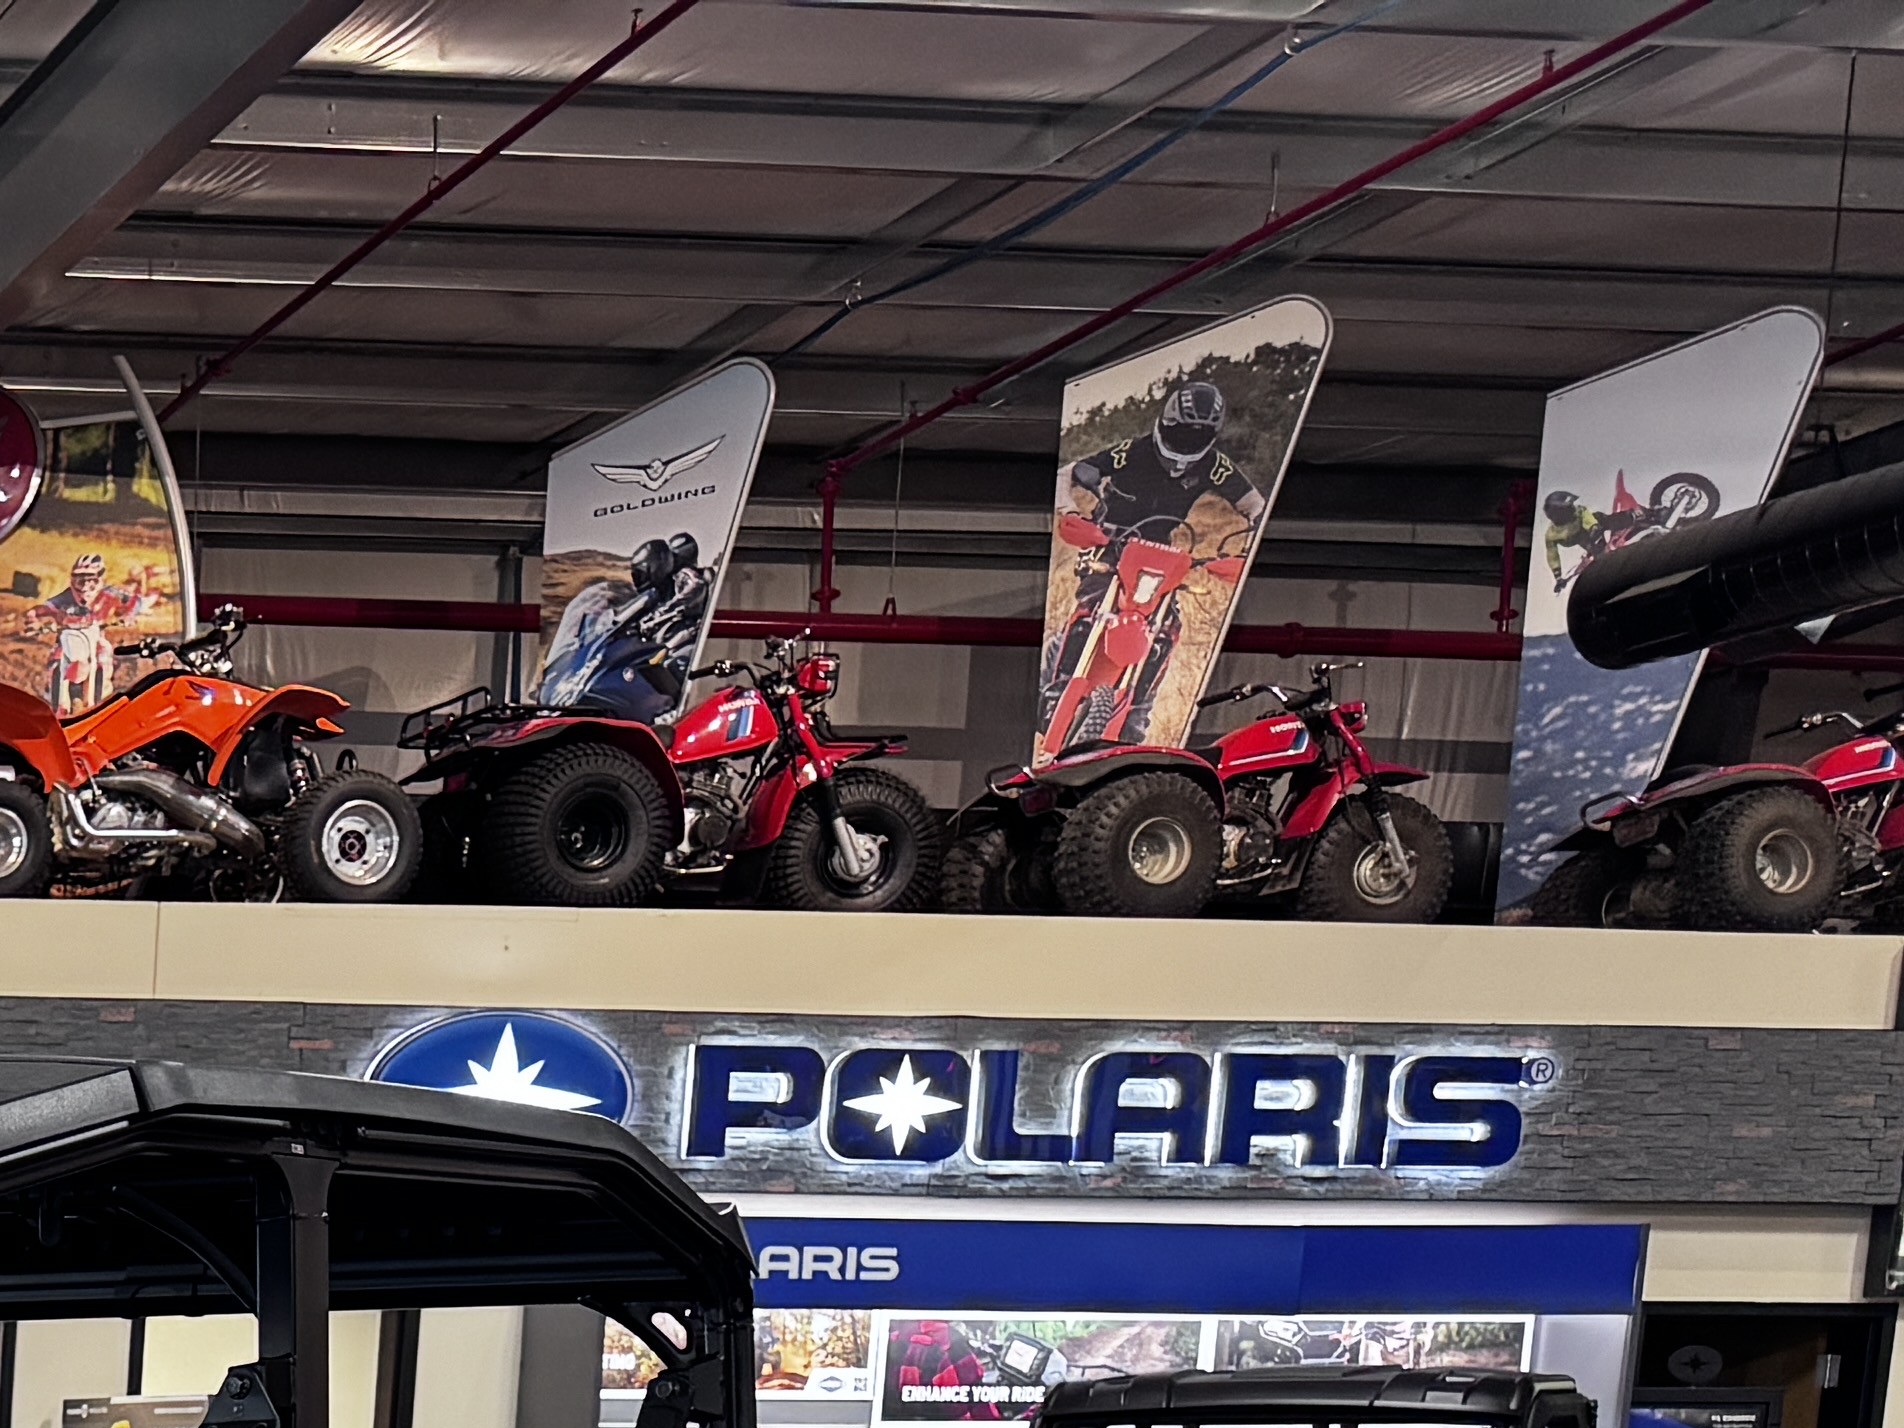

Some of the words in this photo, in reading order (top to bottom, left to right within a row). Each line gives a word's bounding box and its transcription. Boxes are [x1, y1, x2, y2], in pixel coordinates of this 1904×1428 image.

[593, 484, 716, 519] GOLDWING
[685, 1043, 1526, 1168] POLARIS
[759, 1246, 899, 1281] ARIS
[902, 1385, 969, 1402] ENHANCE
[971, 1385, 1009, 1402] YOUR
[1011, 1385, 1045, 1403] RIDE
